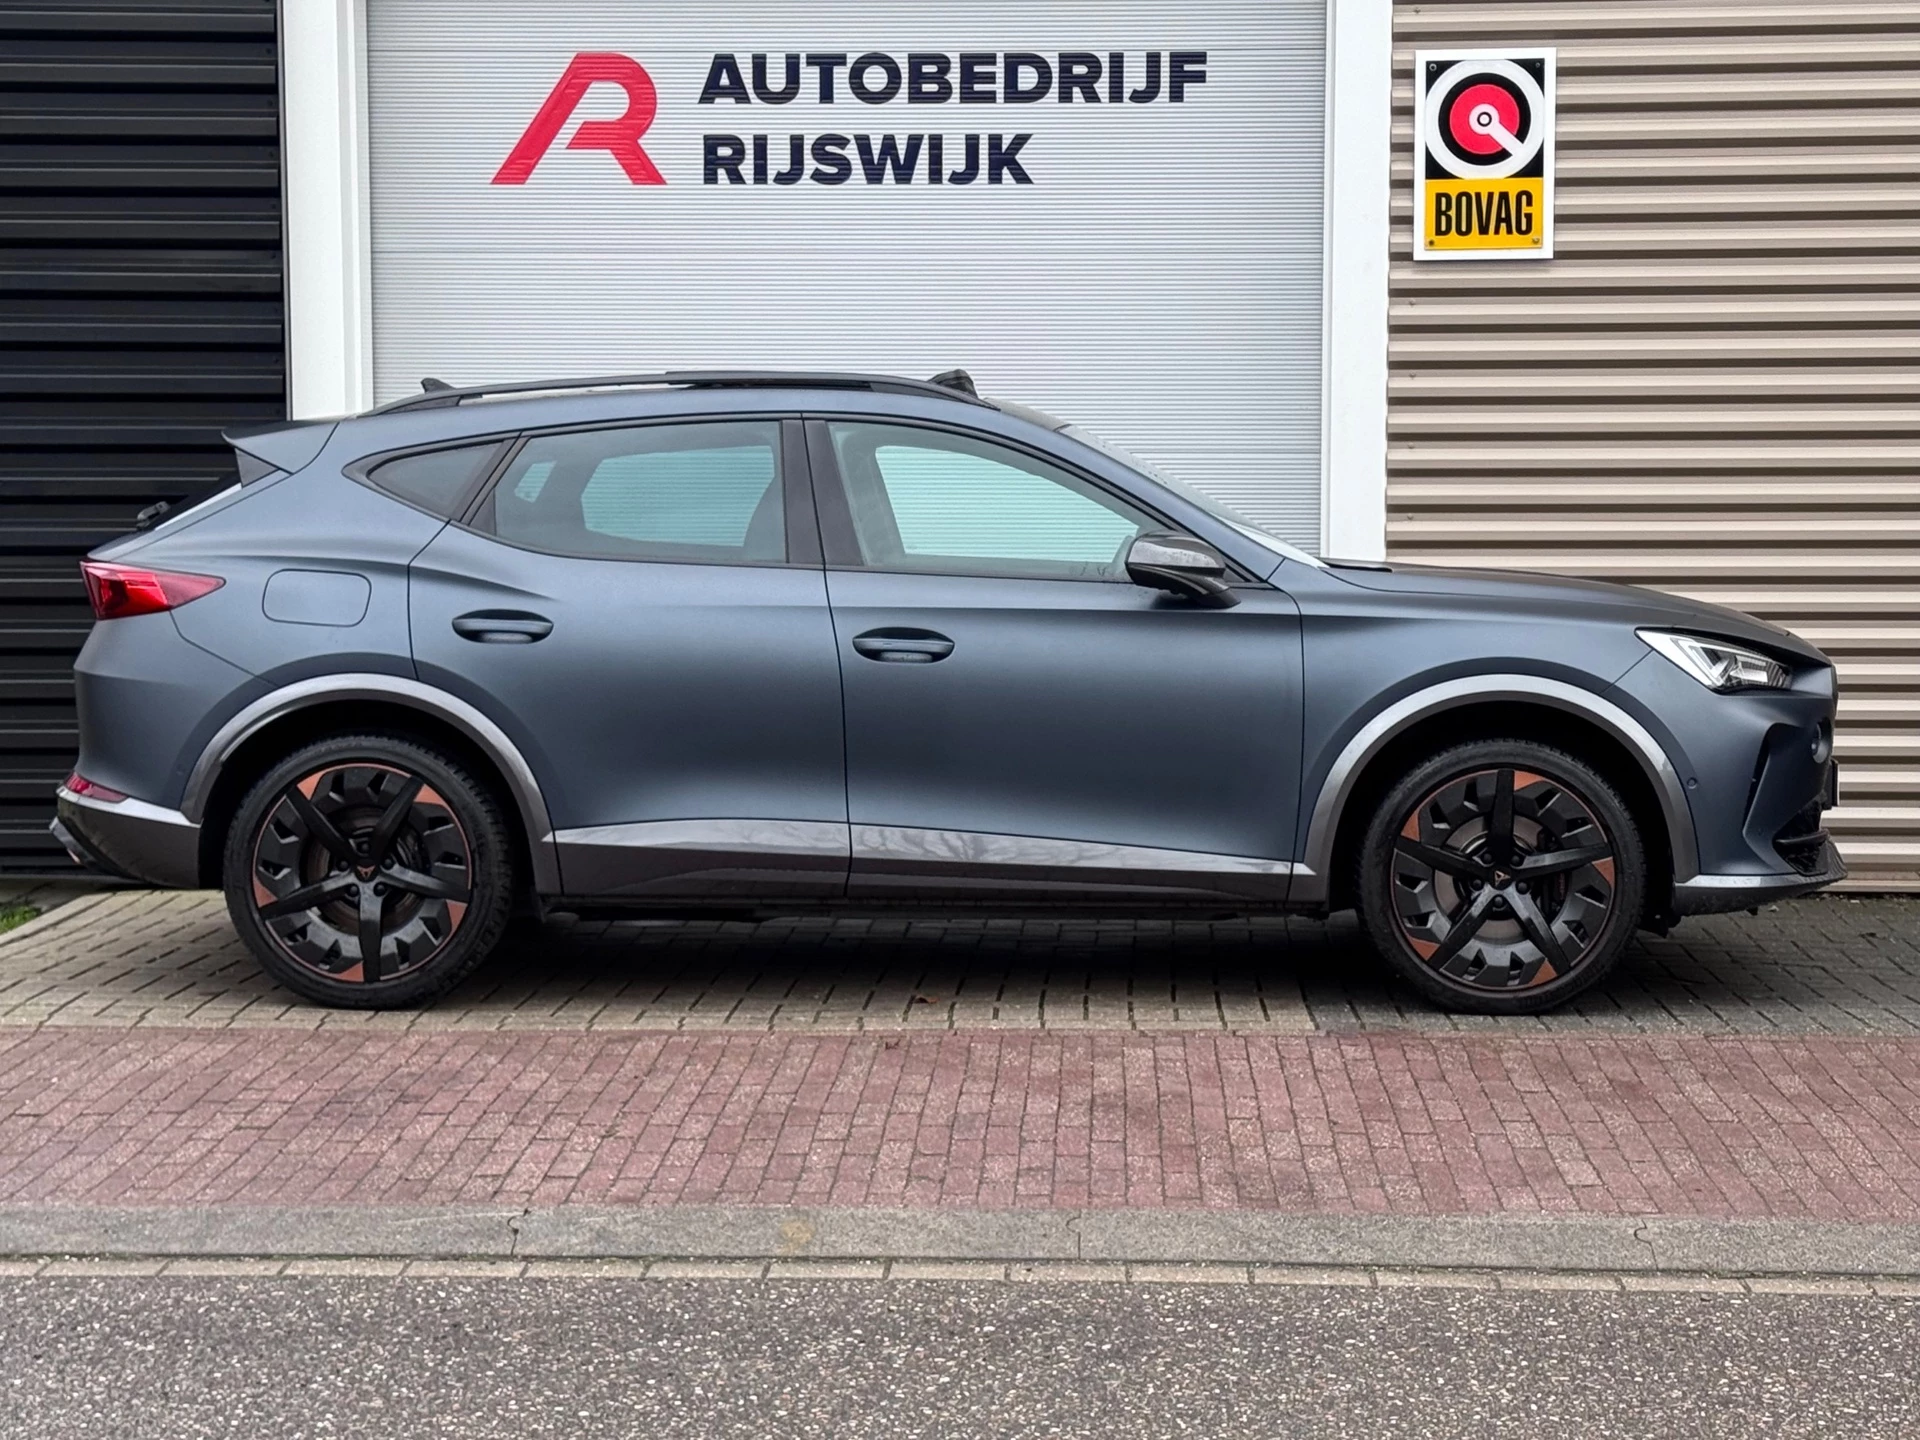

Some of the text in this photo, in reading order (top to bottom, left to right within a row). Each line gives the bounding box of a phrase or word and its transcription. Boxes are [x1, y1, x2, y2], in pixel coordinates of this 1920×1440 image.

[698, 51, 1208, 105] AUTOBEDRIJF
[703, 133, 1034, 186] RIJSWIJK
[1435, 190, 1533, 237] BOVAG
